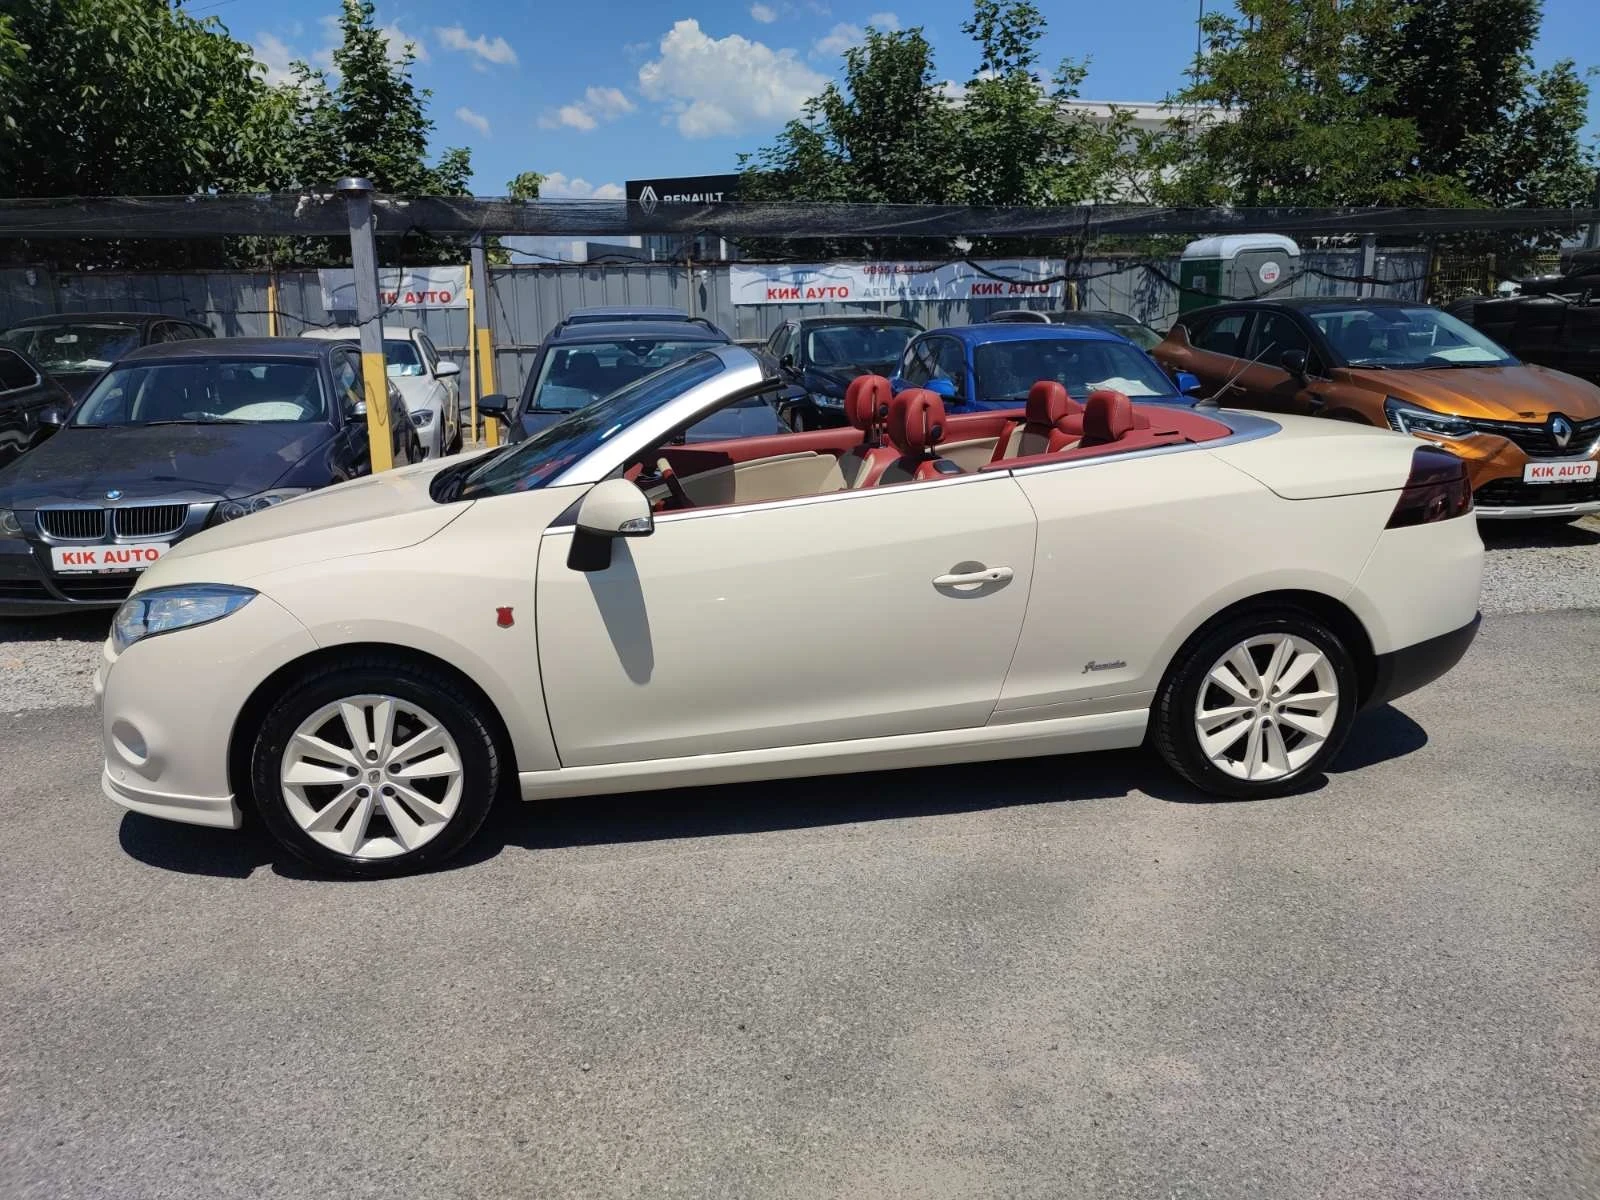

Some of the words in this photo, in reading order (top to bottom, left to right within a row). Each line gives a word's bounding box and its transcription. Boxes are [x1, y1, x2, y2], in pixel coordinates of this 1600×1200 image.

[664, 192, 724, 203] RENAULT
[767, 288, 800, 299] КИК
[806, 286, 849, 298] АУТО
[971, 283, 1003, 295] КИК
[404, 291, 451, 303] АУТО
[1531, 467, 1554, 477] KIK
[1559, 465, 1591, 476] AUTO
[62, 552, 96, 564] KIK
[104, 548, 159, 563] AUTO
